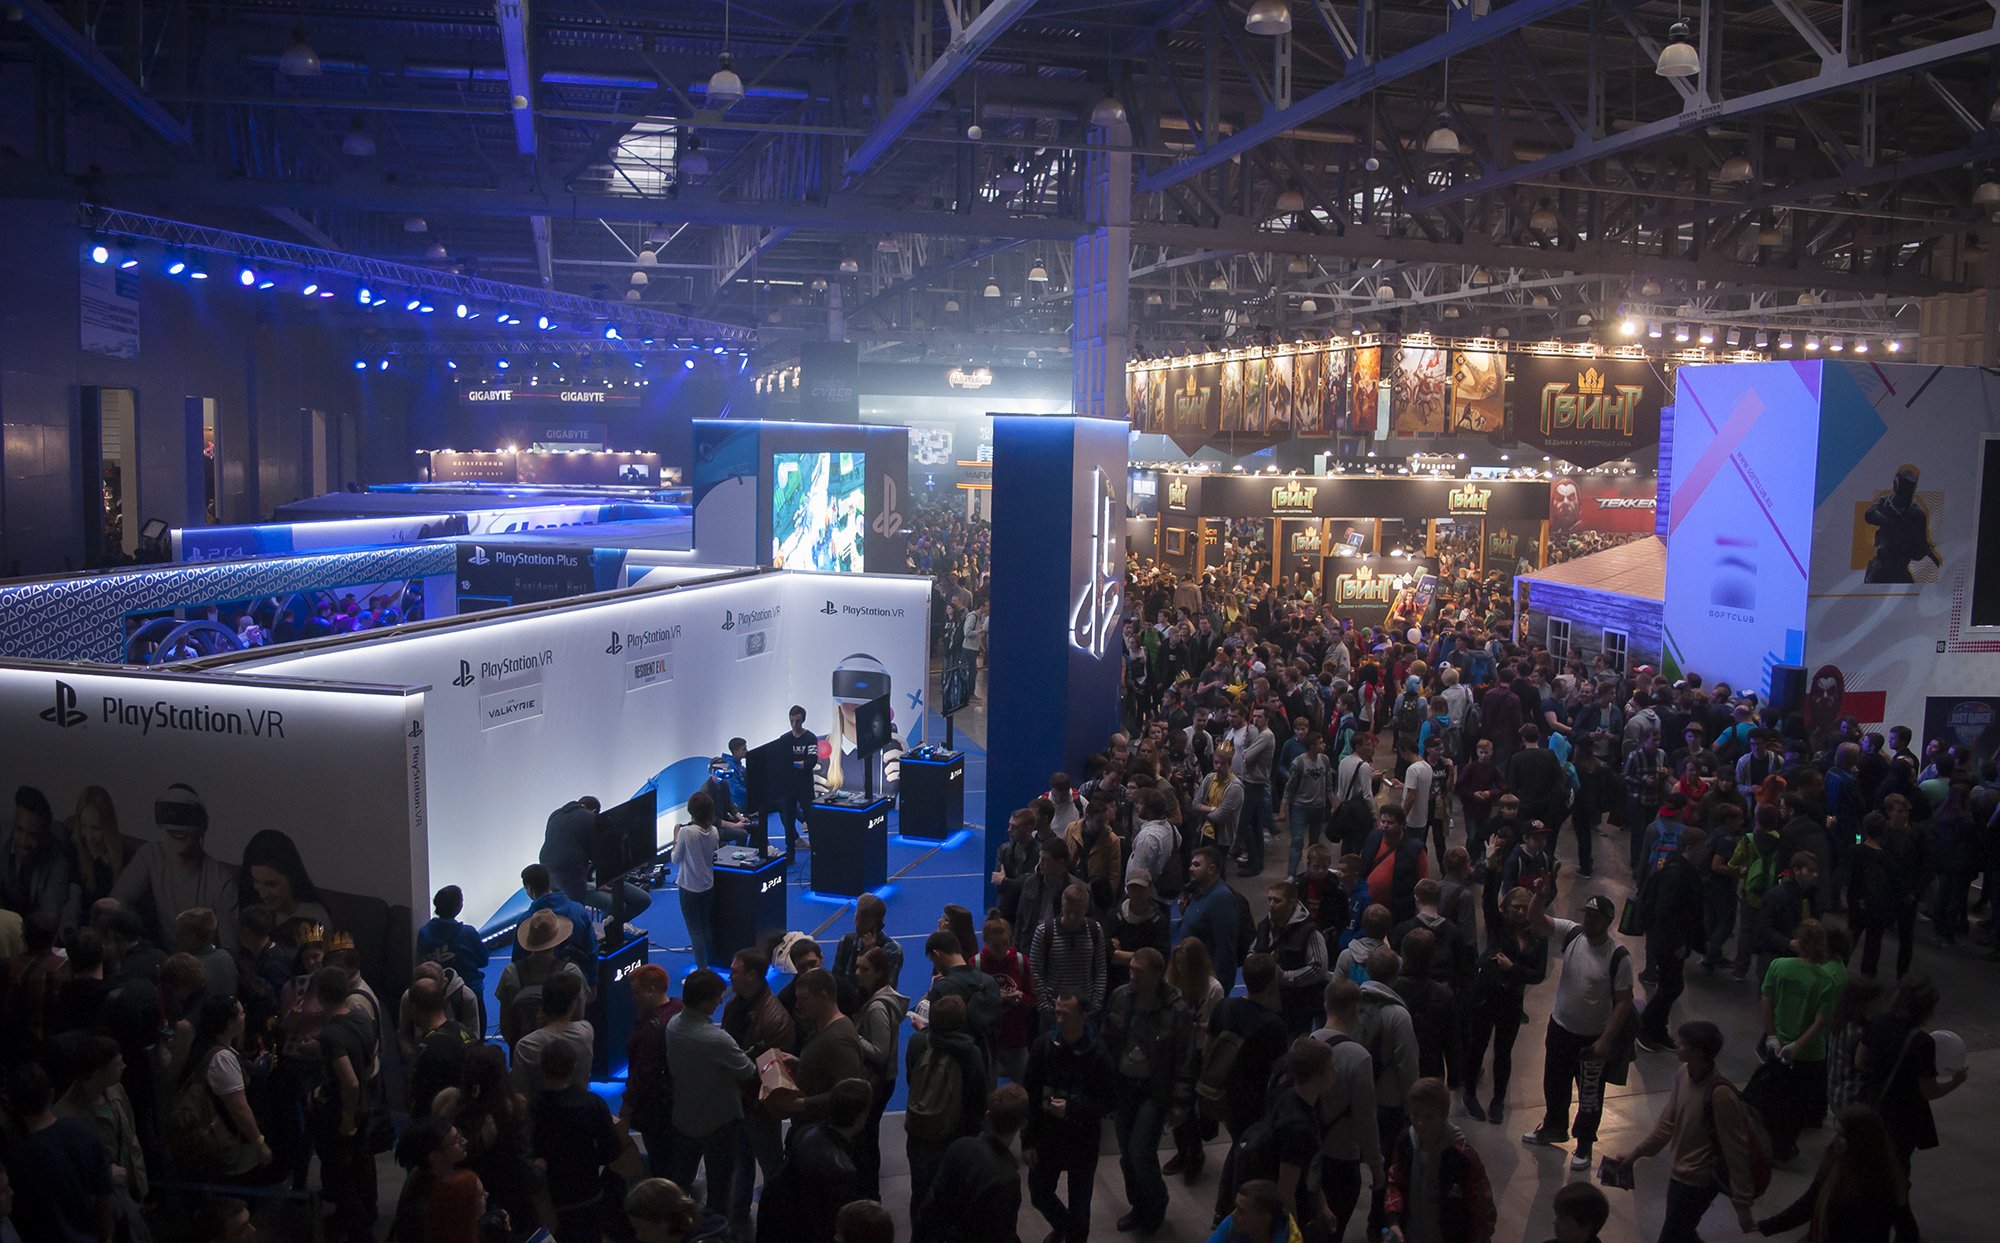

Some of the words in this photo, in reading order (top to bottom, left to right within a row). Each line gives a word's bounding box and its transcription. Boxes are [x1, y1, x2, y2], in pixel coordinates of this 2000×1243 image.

[469, 390, 512, 401] GIGABYTE
[560, 392, 605, 402] GIGABYTE
[1174, 387, 1211, 430] ГВИНТ
[1540, 382, 1644, 436] ГВИНТ
[546, 430, 589, 439] GIGABYTE
[1271, 486, 1318, 509] ГВИНТ
[1448, 489, 1491, 511] ГВИНТ
[496, 552, 554, 567] PlayStation
[556, 554, 578, 566] Plus
[1336, 573, 1397, 603] ГВИНТ
[738, 608, 772, 626] PlayStation
[772, 605, 782, 617] VR
[842, 605, 891, 617] PlayStation
[892, 608, 905, 617] VR
[1708, 609, 1755, 623] SOFTCLUB
[627, 629, 670, 649] PlayStation
[671, 625, 682, 639] VR
[481, 655, 538, 680] PlayStation
[539, 650, 553, 666] VR
[103, 696, 242, 735] PlayStation
[247, 708, 285, 738] VR
[488, 699, 536, 718] VALKYRIE
[411, 745, 421, 809] PlayStation
[415, 810, 423, 827] VR
[873, 815, 884, 827] PS4
[768, 875, 782, 889] PS4
[623, 959, 642, 976] PS4
